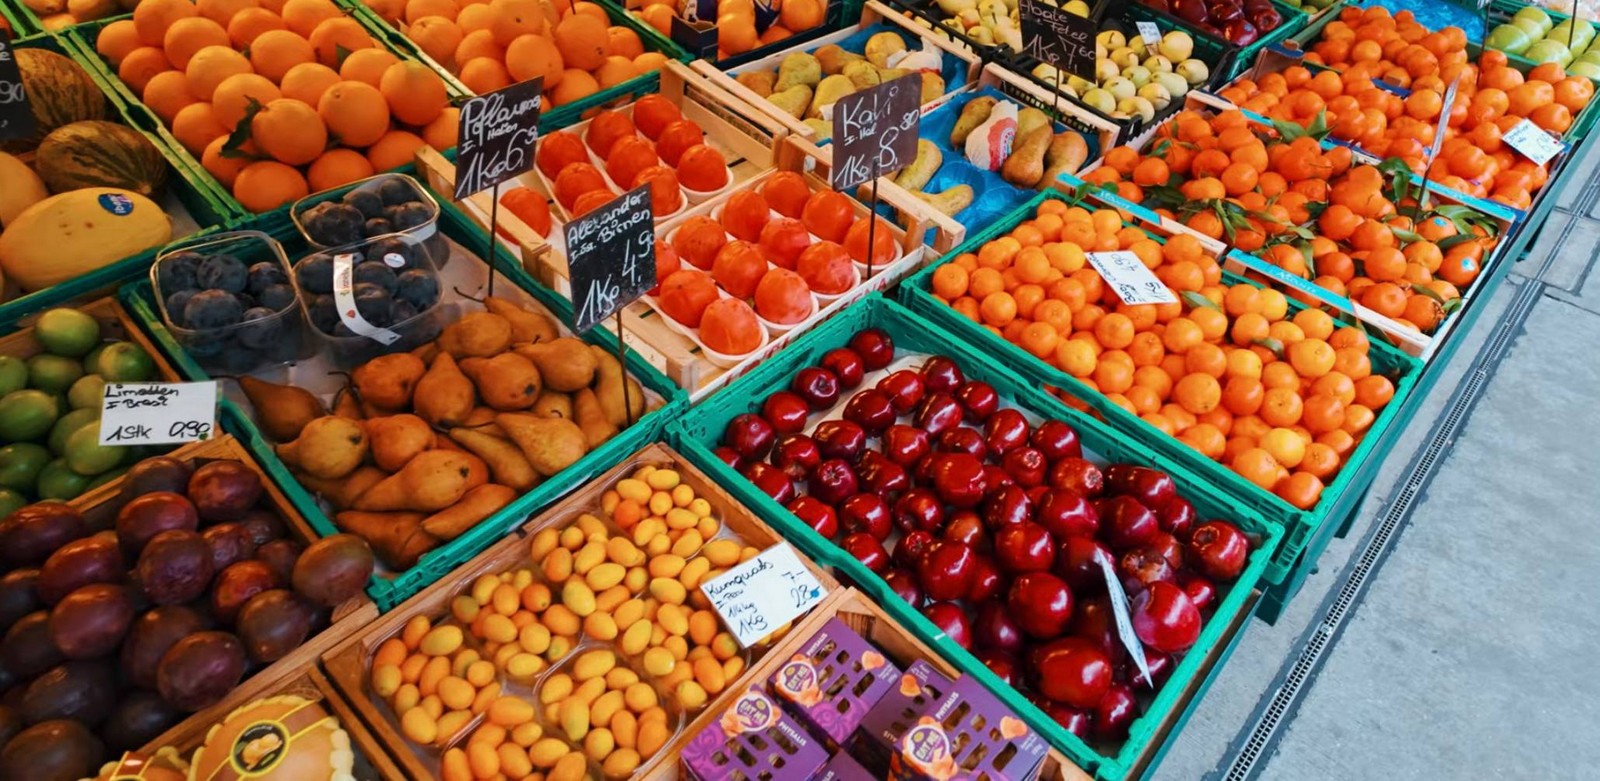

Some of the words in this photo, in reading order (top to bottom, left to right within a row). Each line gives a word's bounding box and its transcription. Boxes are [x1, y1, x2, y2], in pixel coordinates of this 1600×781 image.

[567, 191, 647, 248] Alexander
[705, 557, 774, 600] Kumquats
[806, 632, 829, 656] PHYSALIS
[935, 690, 960, 720] PHYSALIS
[778, 720, 808, 747] PHYSALIS
